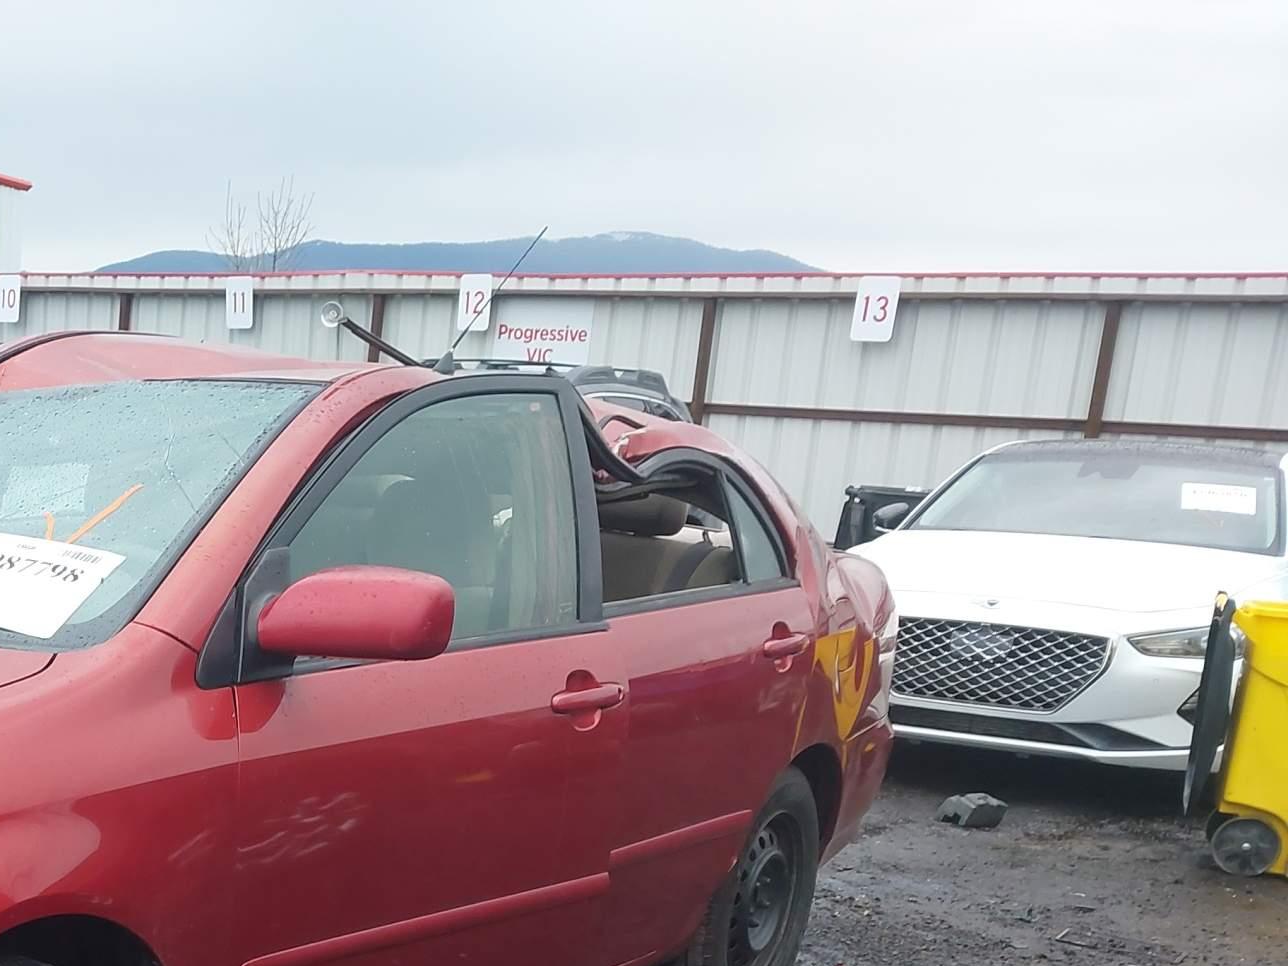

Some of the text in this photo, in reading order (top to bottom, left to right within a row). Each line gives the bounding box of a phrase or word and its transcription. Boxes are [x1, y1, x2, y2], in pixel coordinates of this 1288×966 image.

[1, 288, 17, 309] 10
[233, 291, 245, 313] 11
[464, 290, 486, 315] 12
[861, 295, 890, 323] 13
[497, 323, 588, 343] Progressive
[526, 347, 554, 363] VIC
